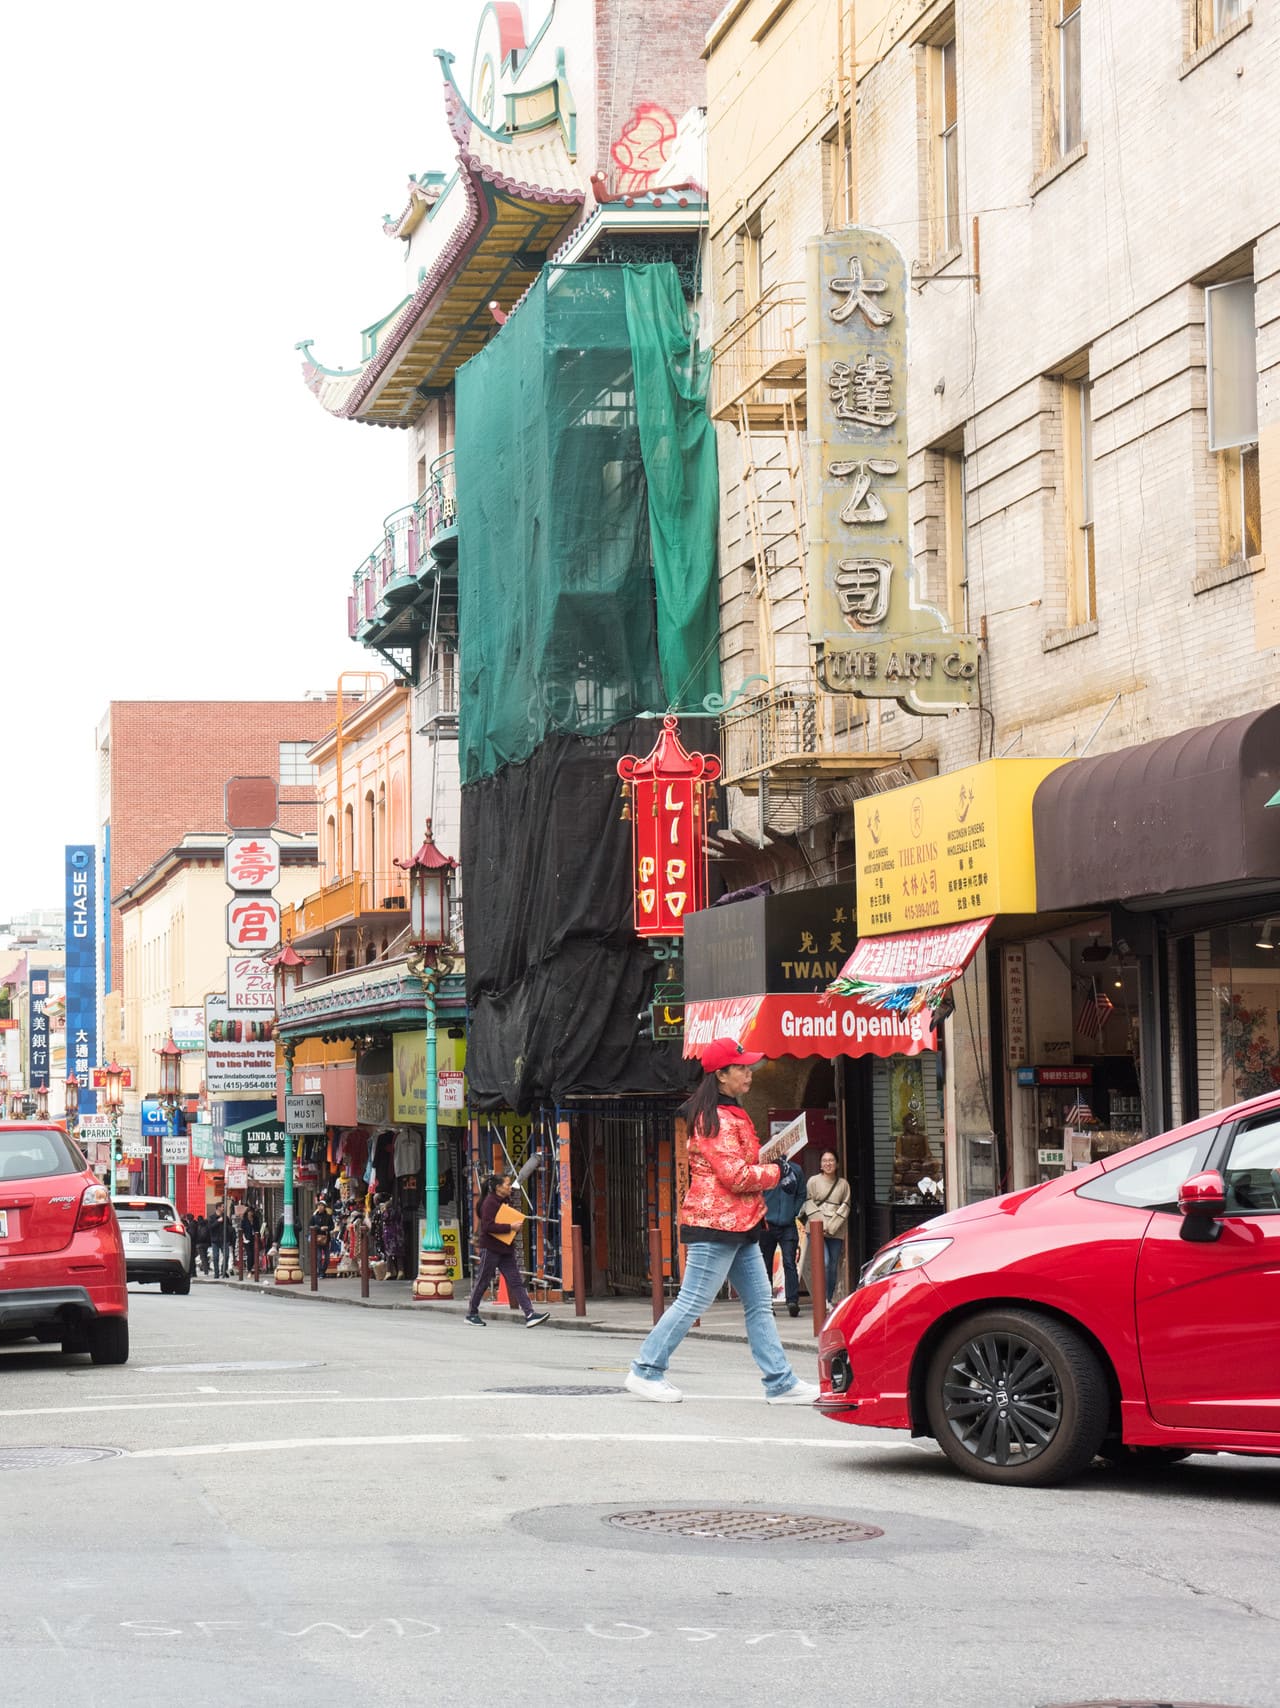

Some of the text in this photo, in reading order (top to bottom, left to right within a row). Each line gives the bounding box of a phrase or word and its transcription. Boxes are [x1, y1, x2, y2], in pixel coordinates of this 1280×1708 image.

[827, 255, 900, 625] 大達公司
[831, 650, 877, 678] THE
[886, 650, 936, 678] ART
[898, 847, 915, 868] THE
[916, 842, 937, 864] RIMS
[903, 869, 937, 896] 大林公司
[73, 871, 87, 938] CHASE
[234, 960, 275, 978] Gra
[236, 993, 274, 1005] RESTA
[32, 1000, 47, 1065] 華美銀行
[781, 1010, 922, 1041] Grand Opening
[75, 1028, 89, 1088] 大通銀行
[207, 1050, 275, 1058] Wholesale Pric
[294, 1110, 315, 1118] MUST
[247, 1132, 271, 1141] LINDA
